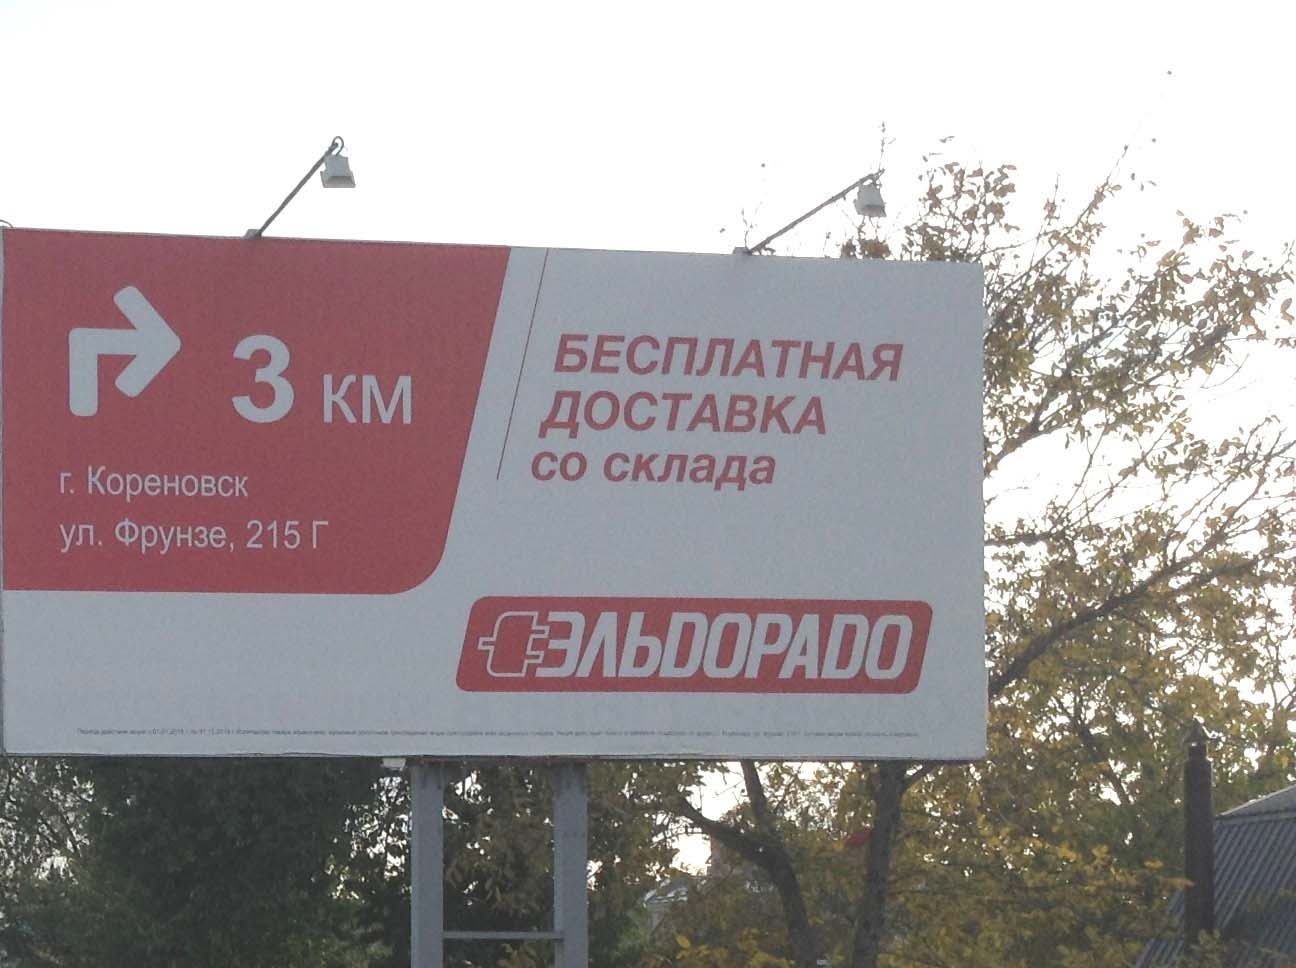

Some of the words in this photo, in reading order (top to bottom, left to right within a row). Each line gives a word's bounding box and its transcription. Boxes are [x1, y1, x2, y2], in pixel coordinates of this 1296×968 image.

[231, 333, 295, 423] 3
[553, 333, 904, 382] БЕСПЛАТНАЯ
[538, 390, 827, 439] ДОСТАВКА
[60, 472, 75, 495] г.
[87, 465, 249, 502] Кореновск
[531, 451, 588, 481] со
[603, 452, 777, 491] склада
[60, 524, 103, 552] ул.
[114, 517, 235, 553] Фрунзе,
[245, 520, 301, 549] 215
[312, 520, 329, 549] Г
